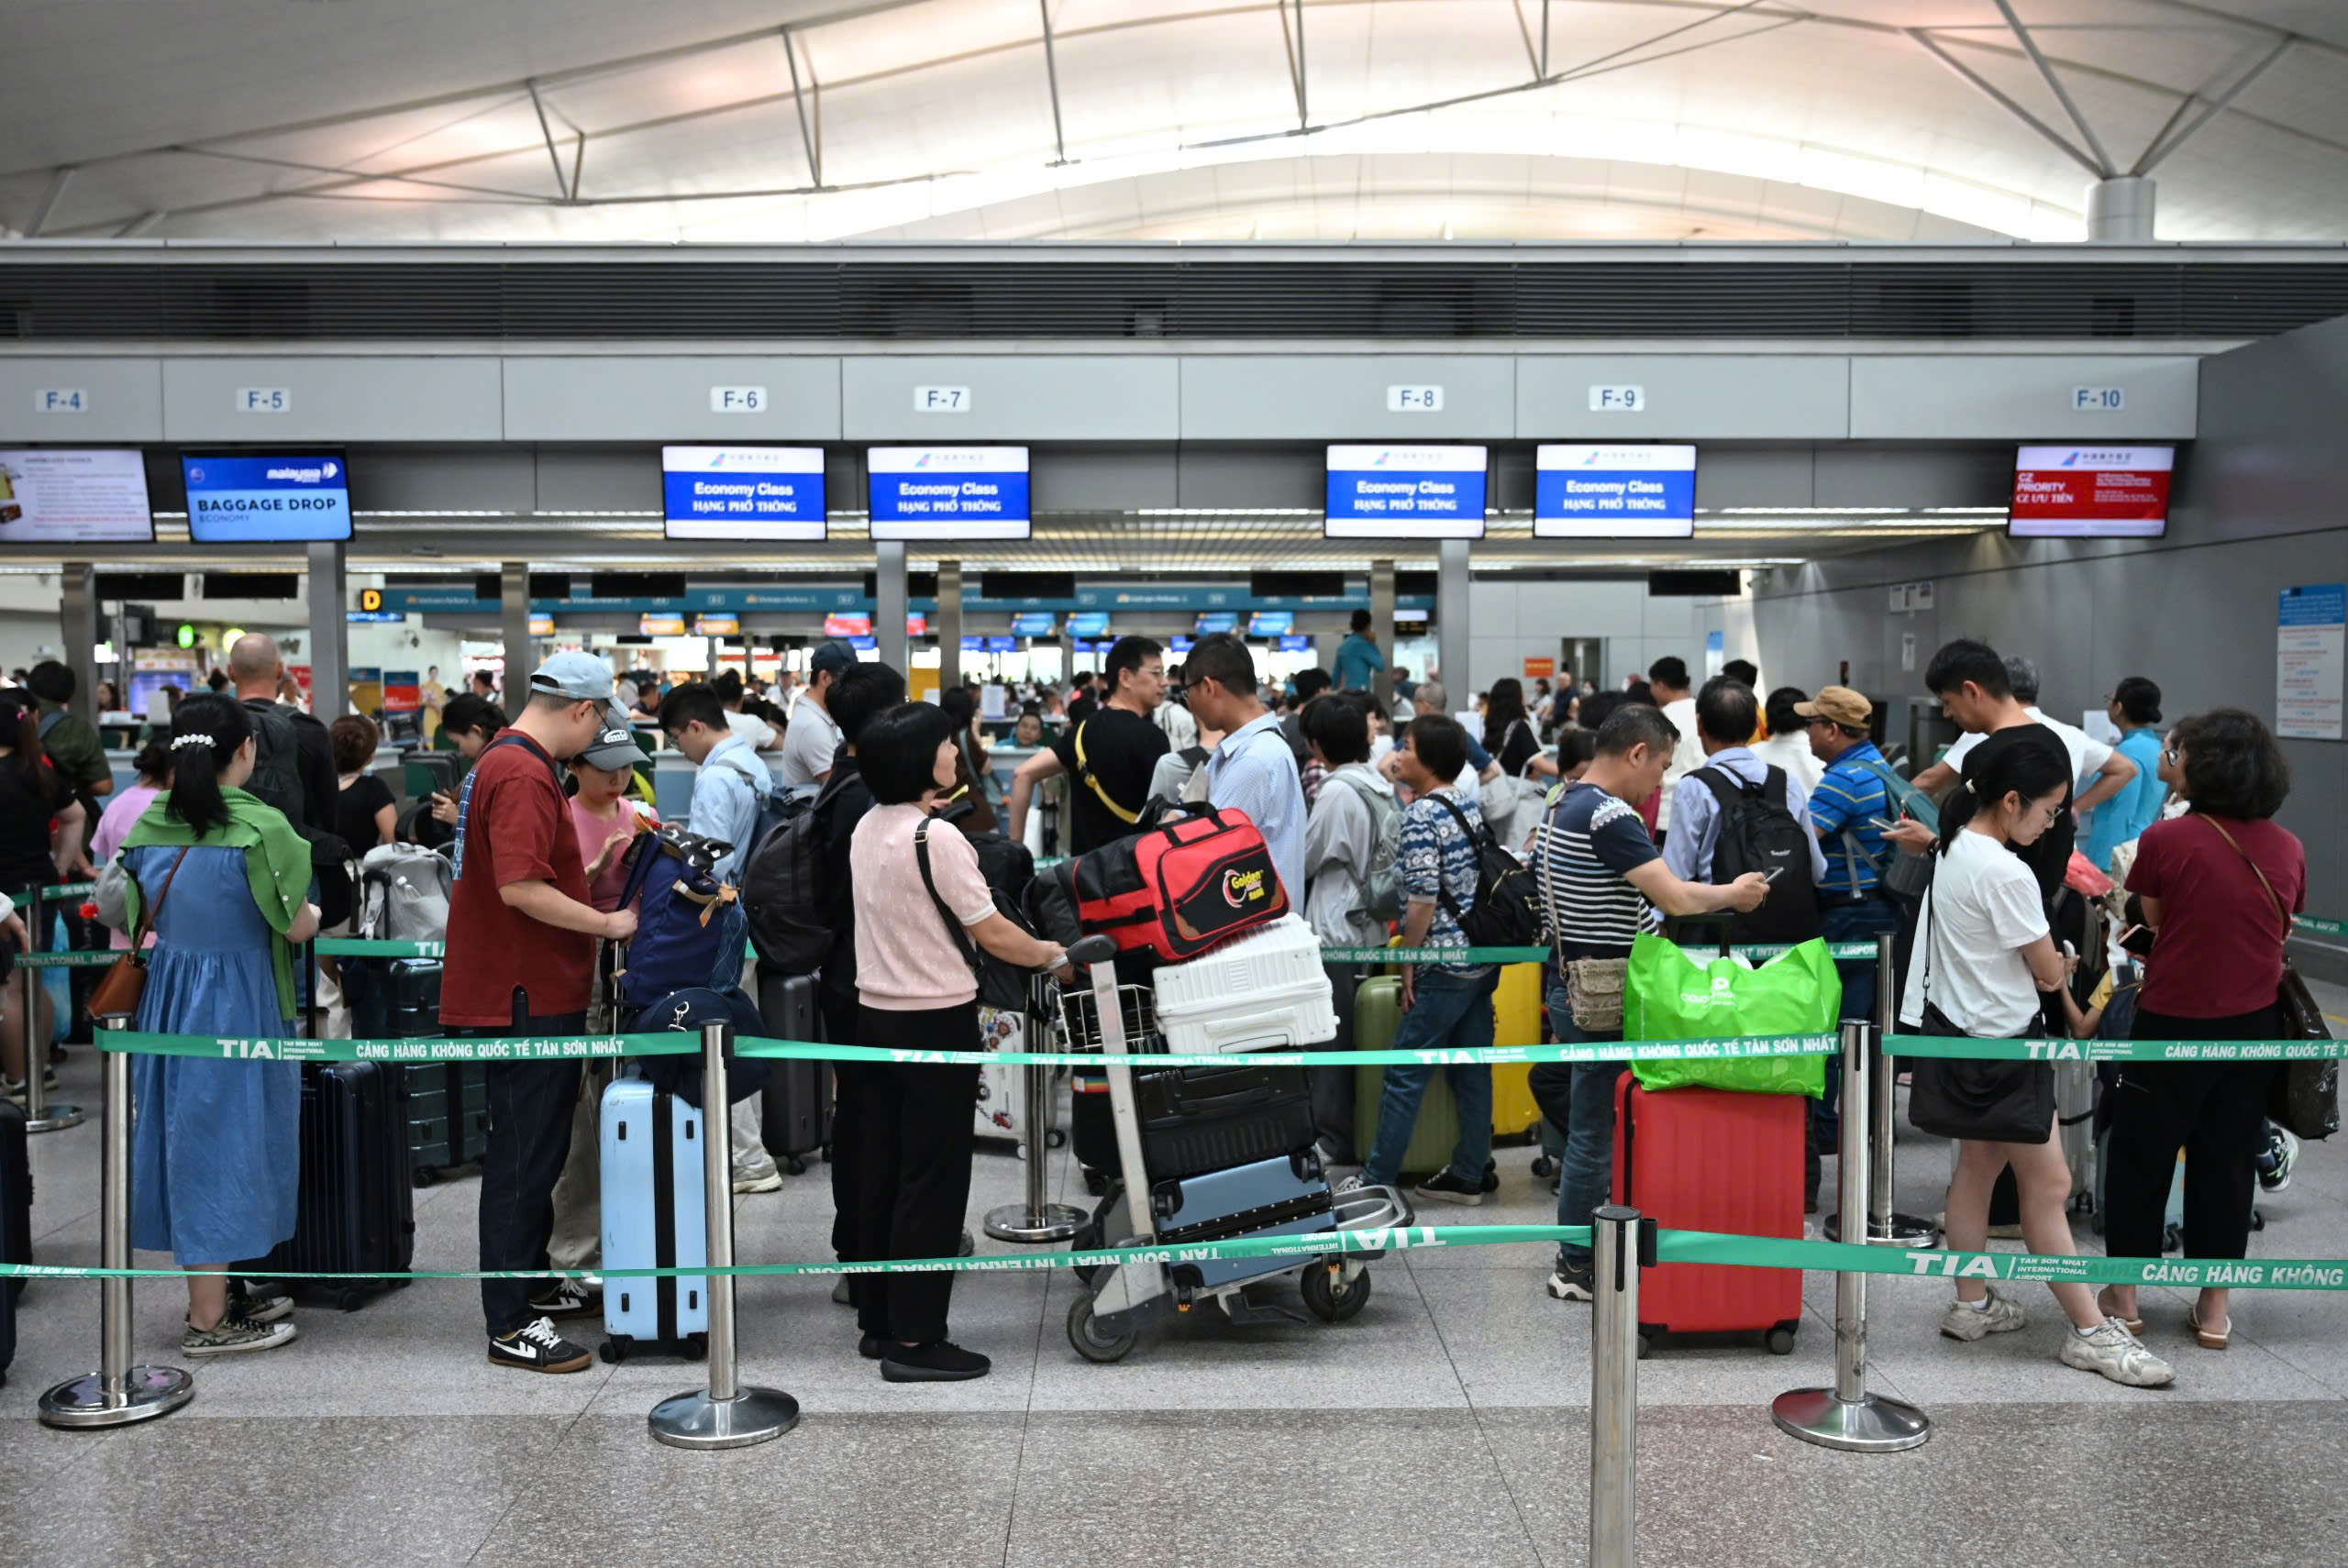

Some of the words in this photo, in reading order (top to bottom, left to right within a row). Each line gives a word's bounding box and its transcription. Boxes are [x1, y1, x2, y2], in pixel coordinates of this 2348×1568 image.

[47, 392, 81, 409] F-4
[249, 392, 282, 408] F-5
[724, 391, 758, 408] F-6
[927, 391, 961, 408] F-7
[1401, 391, 1434, 407] F-8
[1601, 391, 1634, 407] F-9
[2077, 390, 2121, 407] F-10
[694, 482, 755, 498] Economy
[758, 482, 793, 495] Class
[899, 482, 959, 498] Economy
[961, 482, 998, 495] Class
[1357, 480, 1417, 496] Economy
[1418, 480, 1455, 493] Class
[1566, 480, 1626, 495] Economy
[1627, 480, 1664, 493] Class
[198, 499, 283, 512] BAGGAGE
[289, 498, 337, 511] DROP
[199, 514, 249, 523] ECONOMY
[363, 590, 382, 610] D
[1231, 869, 1262, 889] Golden
[216, 1039, 275, 1059] TIA
[357, 1040, 390, 1058] CẢNG
[394, 1041, 427, 1058] HÀNG
[431, 1041, 472, 1058] KHÔNG
[478, 1039, 510, 1057] QUỐC
[515, 1038, 530, 1055] TẾ
[535, 1040, 559, 1055] TÂN
[563, 1039, 587, 1055] SƠN
[592, 1037, 625, 1054] NHẤT
[1599, 1044, 1633, 1060] HÀNG
[1637, 1043, 1681, 1058] KHÔNG
[1684, 1039, 1720, 1055] QUỐC
[1722, 1038, 1739, 1055] TẾ
[1744, 1039, 1769, 1055] TÂN
[1773, 1037, 1799, 1054] SƠN
[1803, 1033, 1836, 1052] NHẤT
[2024, 1042, 2081, 1060] TIA
[2202, 1043, 2235, 1058] HÀNG
[2240, 1043, 2281, 1058] KHÔNG
[2286, 1042, 2319, 1057] QUỐC
[2323, 1041, 2340, 1056] TẾ
[1414, 1051, 1477, 1064] TIA
[1351, 1226, 1446, 1250] TIA
[1180, 1247, 1222, 1261] TAN
[1270, 1242, 1338, 1254] INTERNATIONAL
[1067, 1254, 1120, 1266] NHAT
[1129, 1250, 1171, 1264] SON
[1905, 1252, 1999, 1278] TIA
[2017, 1266, 2088, 1275] INTERNATIONAL
[2142, 1260, 2198, 1283] CẢNG
[2205, 1262, 2264, 1284] HÀNG
[2270, 1264, 2343, 1286] KHÔNG
